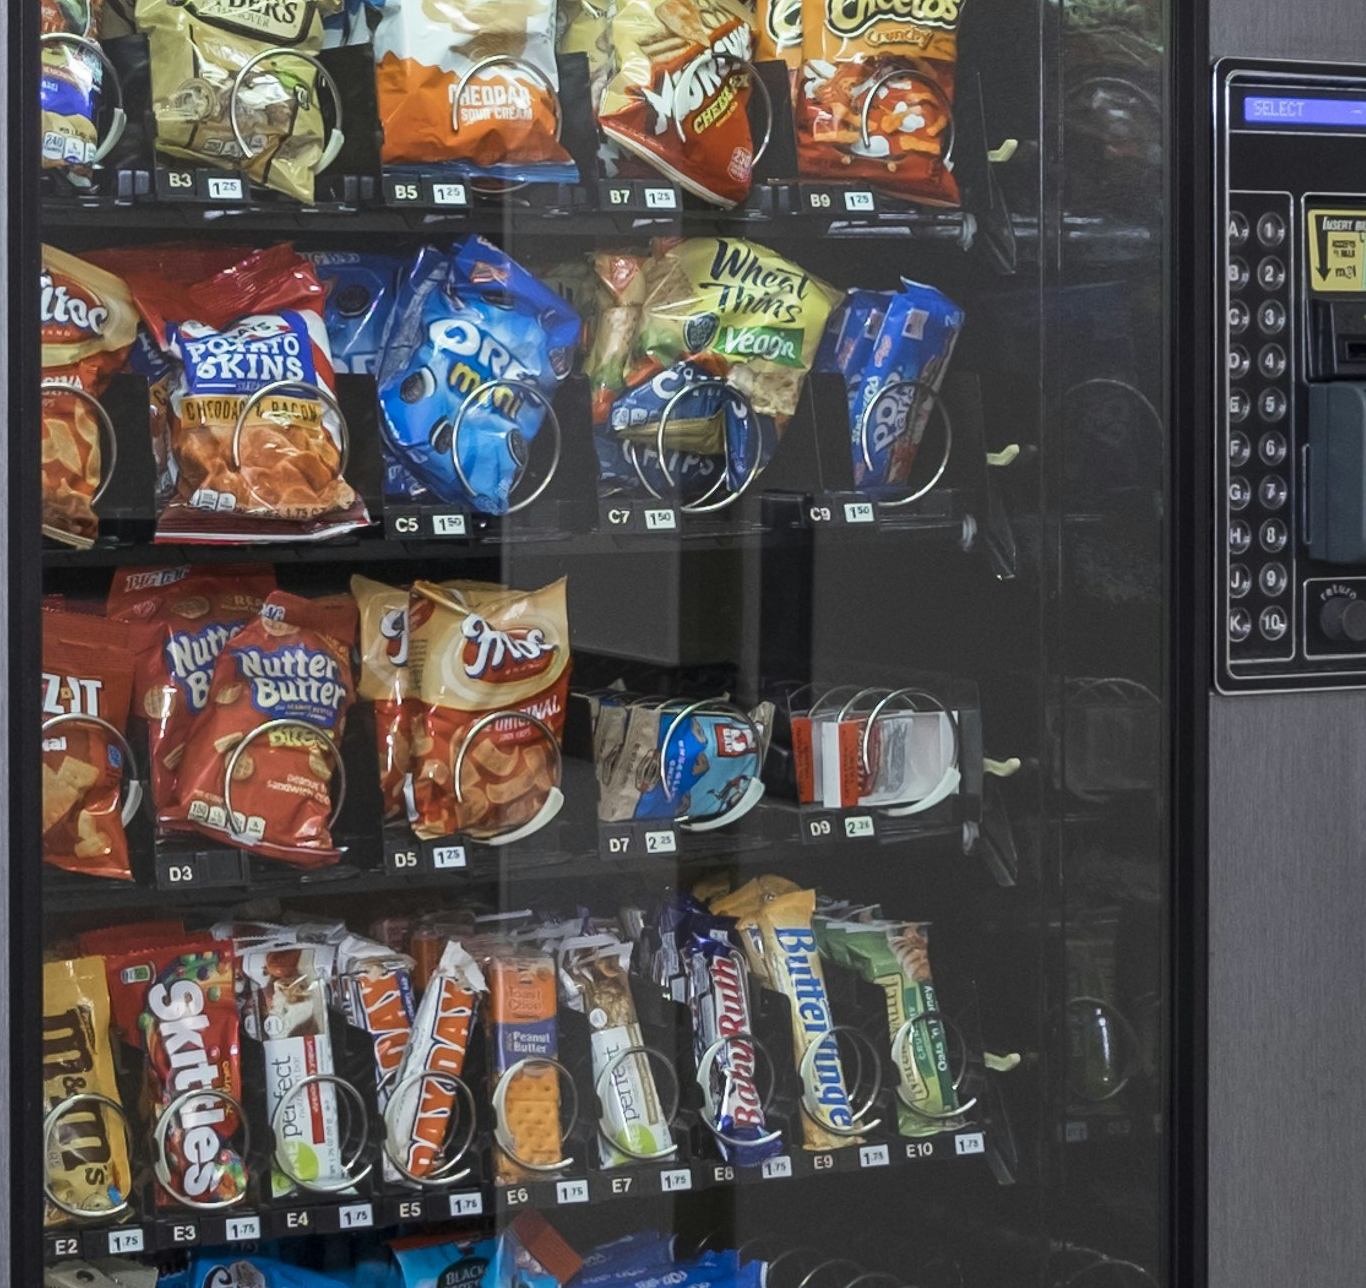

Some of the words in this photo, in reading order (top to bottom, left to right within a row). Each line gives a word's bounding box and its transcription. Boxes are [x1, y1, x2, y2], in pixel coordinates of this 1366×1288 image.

[866, 27, 932, 48] Crunchy
[1252, 100, 1305, 117] SELECT
[169, 173, 192, 187] B3
[395, 185, 418, 199] B5
[610, 190, 630, 204] B7
[810, 194, 831, 208] B9
[710, 238, 810, 301] Wheat
[1264, 268, 1274, 281] 2
[699, 282, 803, 323] Thins
[1264, 309, 1275, 325] 3
[196, 353, 305, 382] SKINS
[1264, 352, 1274, 367] 4
[1265, 396, 1275, 411] 5
[1265, 440, 1275, 456] 6
[1266, 484, 1276, 500] 7
[608, 509, 630, 523] C7
[810, 508, 831, 522] C9
[395, 518, 418, 532] C5
[1266, 527, 1275, 543] 8
[1231, 571, 1240, 586] J
[1266, 570, 1275, 586] 9
[1320, 584, 1357, 601] return
[1230, 615, 1241, 631] K
[1263, 614, 1281, 630] 10
[239, 649, 338, 679] Nutter
[255, 676, 347, 709] Butter
[810, 820, 831, 836] D9
[609, 838, 630, 853] D7
[395, 852, 418, 868] D5
[169, 866, 193, 881] D3
[710, 957, 745, 1037] Ruth
[513, 1031, 550, 1043] Peanut
[513, 1042, 546, 1054] Butter
[935, 1041, 948, 1072] Oats
[408, 976, 476, 1177] PAYDAY
[148, 980, 225, 1196] Skittles
[906, 1143, 933, 1158] E10
[814, 1155, 834, 1169] E9
[715, 1167, 734, 1181] E8
[612, 1179, 632, 1193] E7
[507, 1188, 529, 1205] E6
[400, 1203, 421, 1217] E5
[287, 1212, 308, 1228] E4
[174, 1226, 196, 1241] E3
[55, 1239, 78, 1255] E2
